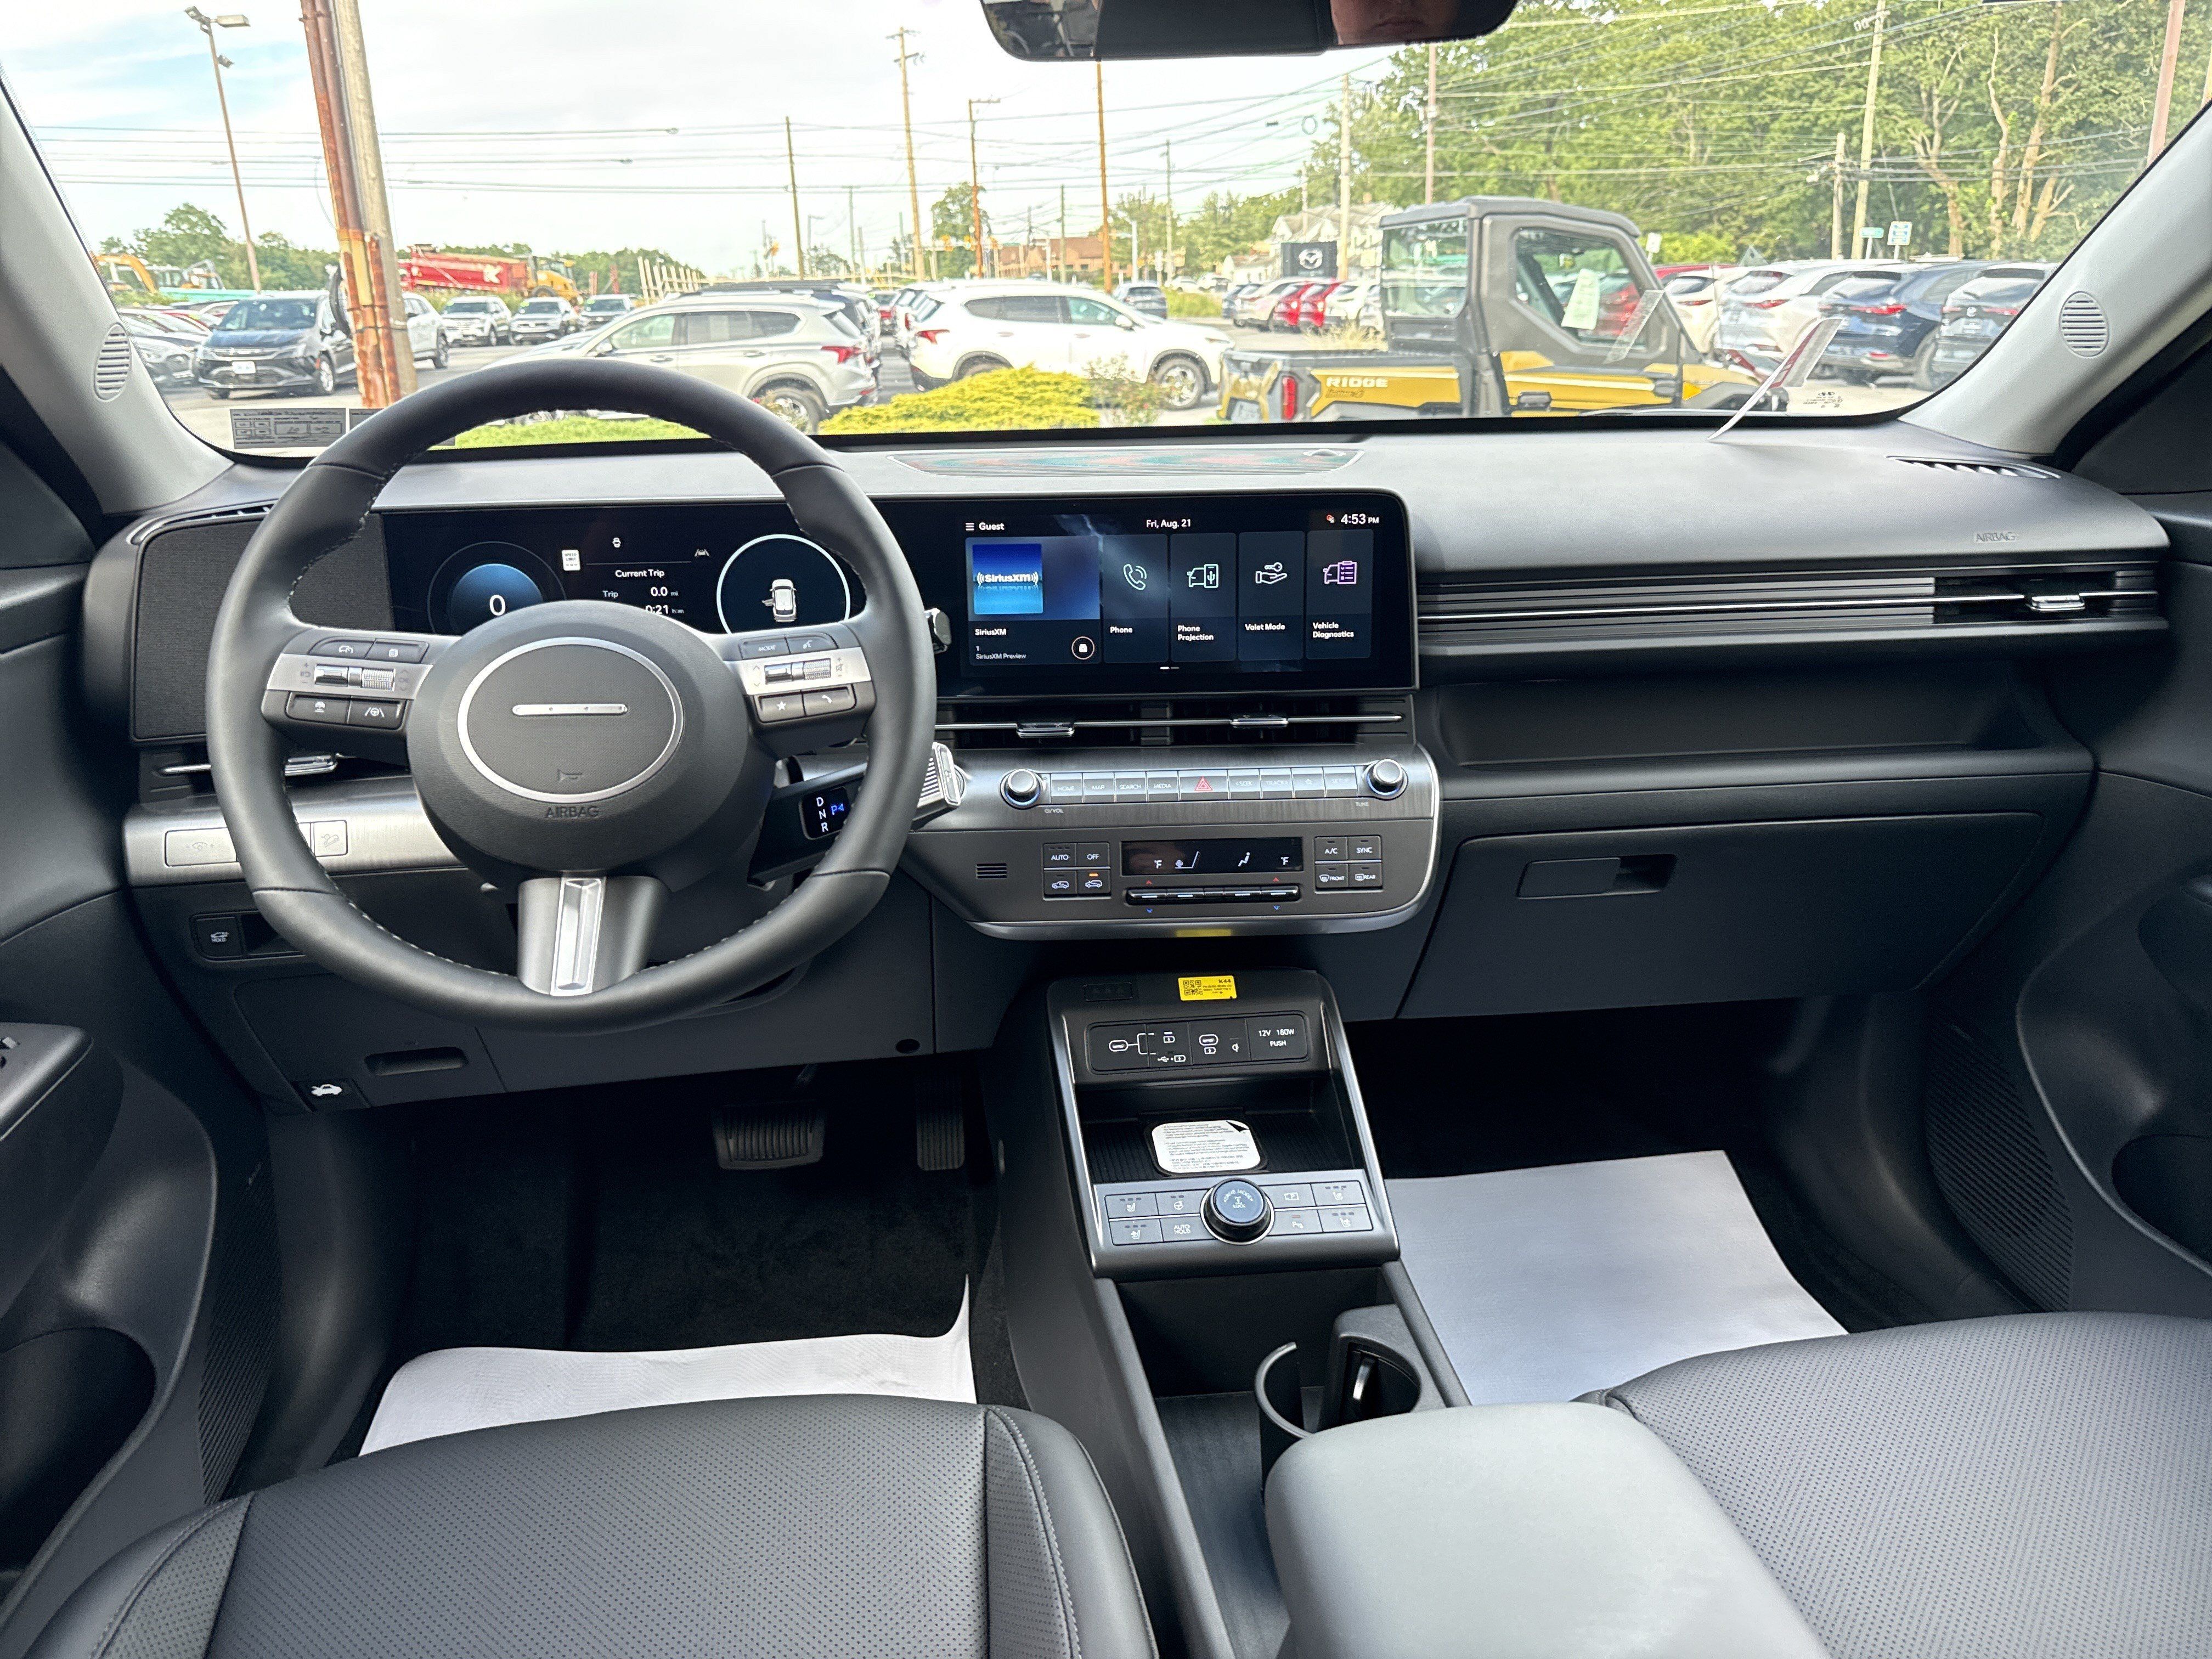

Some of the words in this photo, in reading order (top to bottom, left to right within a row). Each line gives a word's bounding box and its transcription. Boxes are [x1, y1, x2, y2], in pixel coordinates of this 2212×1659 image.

[1326, 377, 1388, 387] RIDGE
[1147, 520, 1159, 528] Fri,
[1161, 519, 1179, 529] Aug.
[1182, 519, 1191, 527] 21
[1341, 514, 1366, 524] 4:53
[979, 522, 1005, 531] Guest
[1976, 532, 2015, 542] AIRBAG
[648, 569, 665, 578] Trip
[985, 574, 1031, 583] SiriusXM
[602, 590, 619, 599] Trip
[650, 586, 668, 597] 0.0
[489, 595, 506, 616] 0
[645, 605, 669, 614] 0:21
[816, 797, 823, 807] D
[545, 805, 600, 819] AIRBAG
[819, 809, 826, 820] N
[831, 805, 838, 815] P
[821, 822, 828, 832] R
